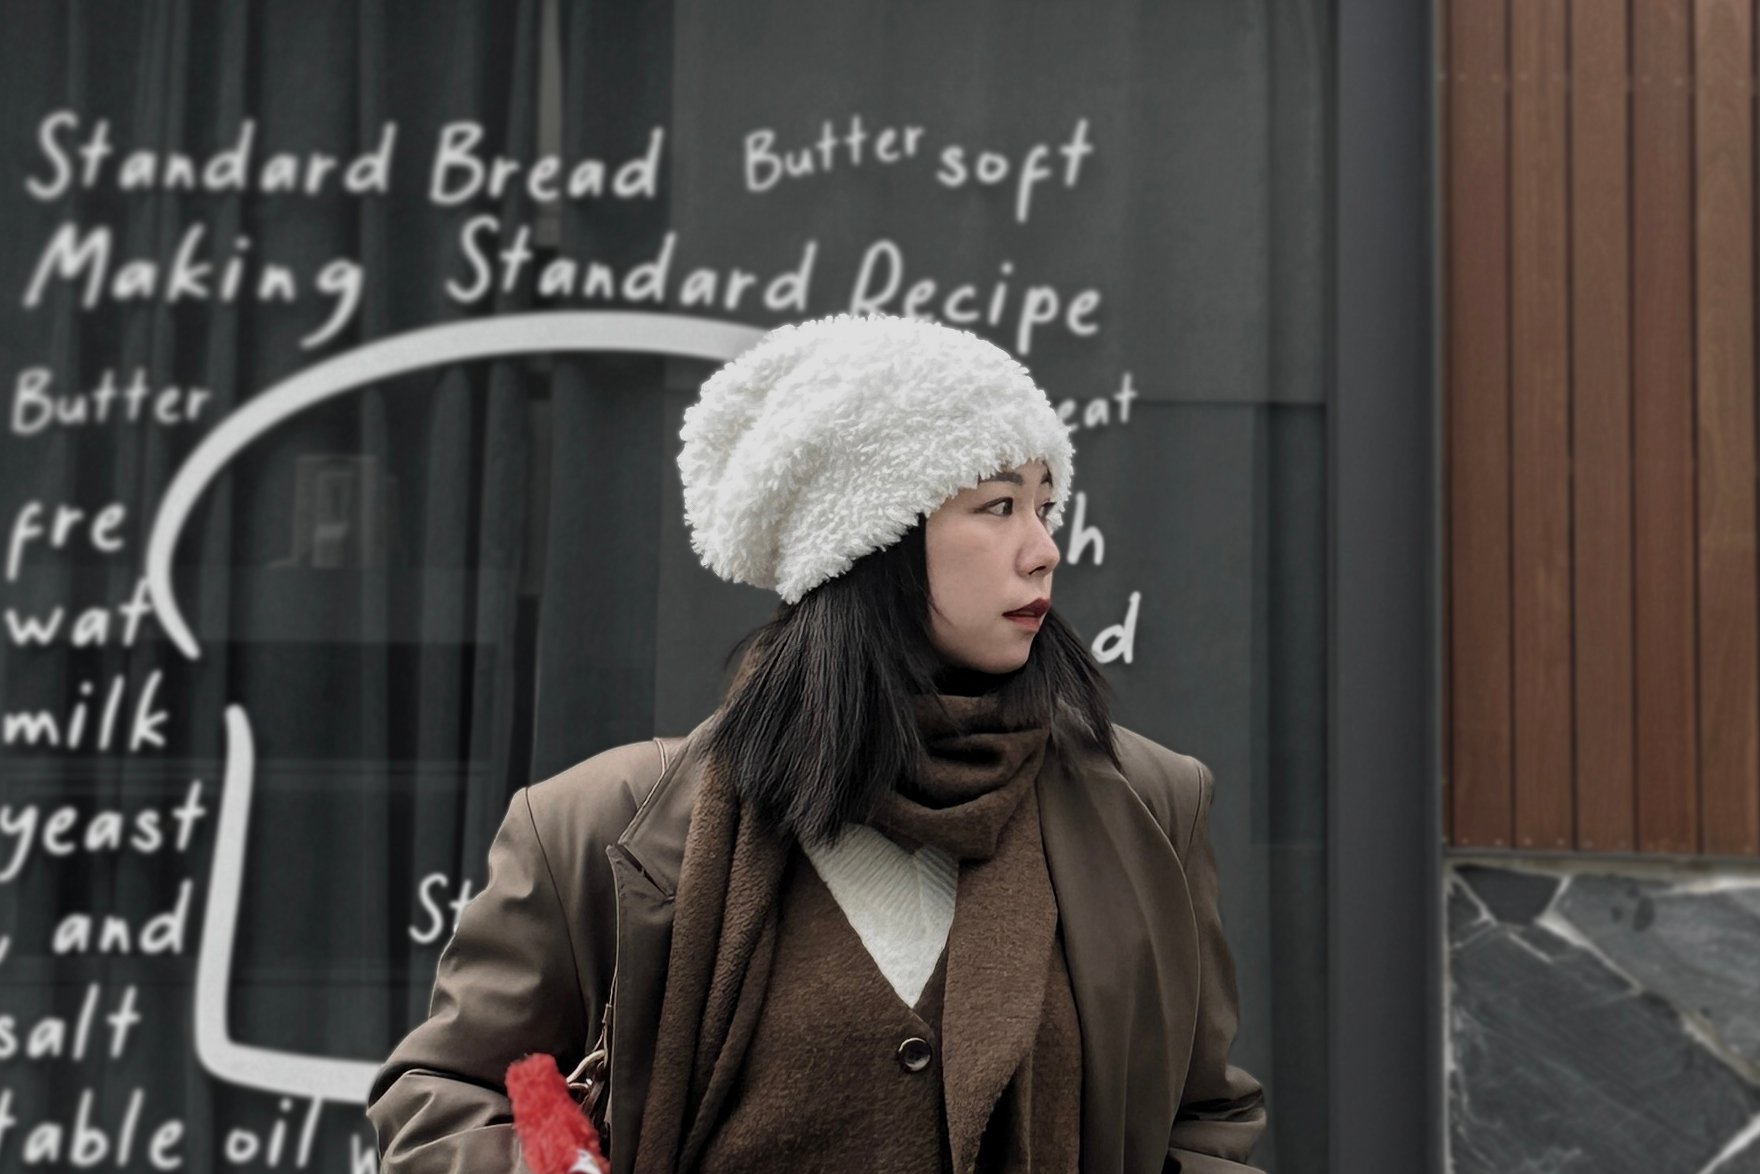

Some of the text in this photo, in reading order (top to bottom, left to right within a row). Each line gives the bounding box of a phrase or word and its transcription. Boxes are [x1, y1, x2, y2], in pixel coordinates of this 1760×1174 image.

[25, 109, 665, 204] Standard Bread
[744, 114, 1094, 224] Butter soft
[22, 214, 1103, 356] Making Standard Recipe
[10, 366, 211, 436] Butter
[6, 500, 127, 582] fre
[3, 578, 150, 648] wat
[1, 669, 168, 752] milk
[0, 780, 207, 884] yeast
[52, 878, 194, 955] and
[0, 983, 141, 1060] salt
[224, 1097, 322, 1169] oil
